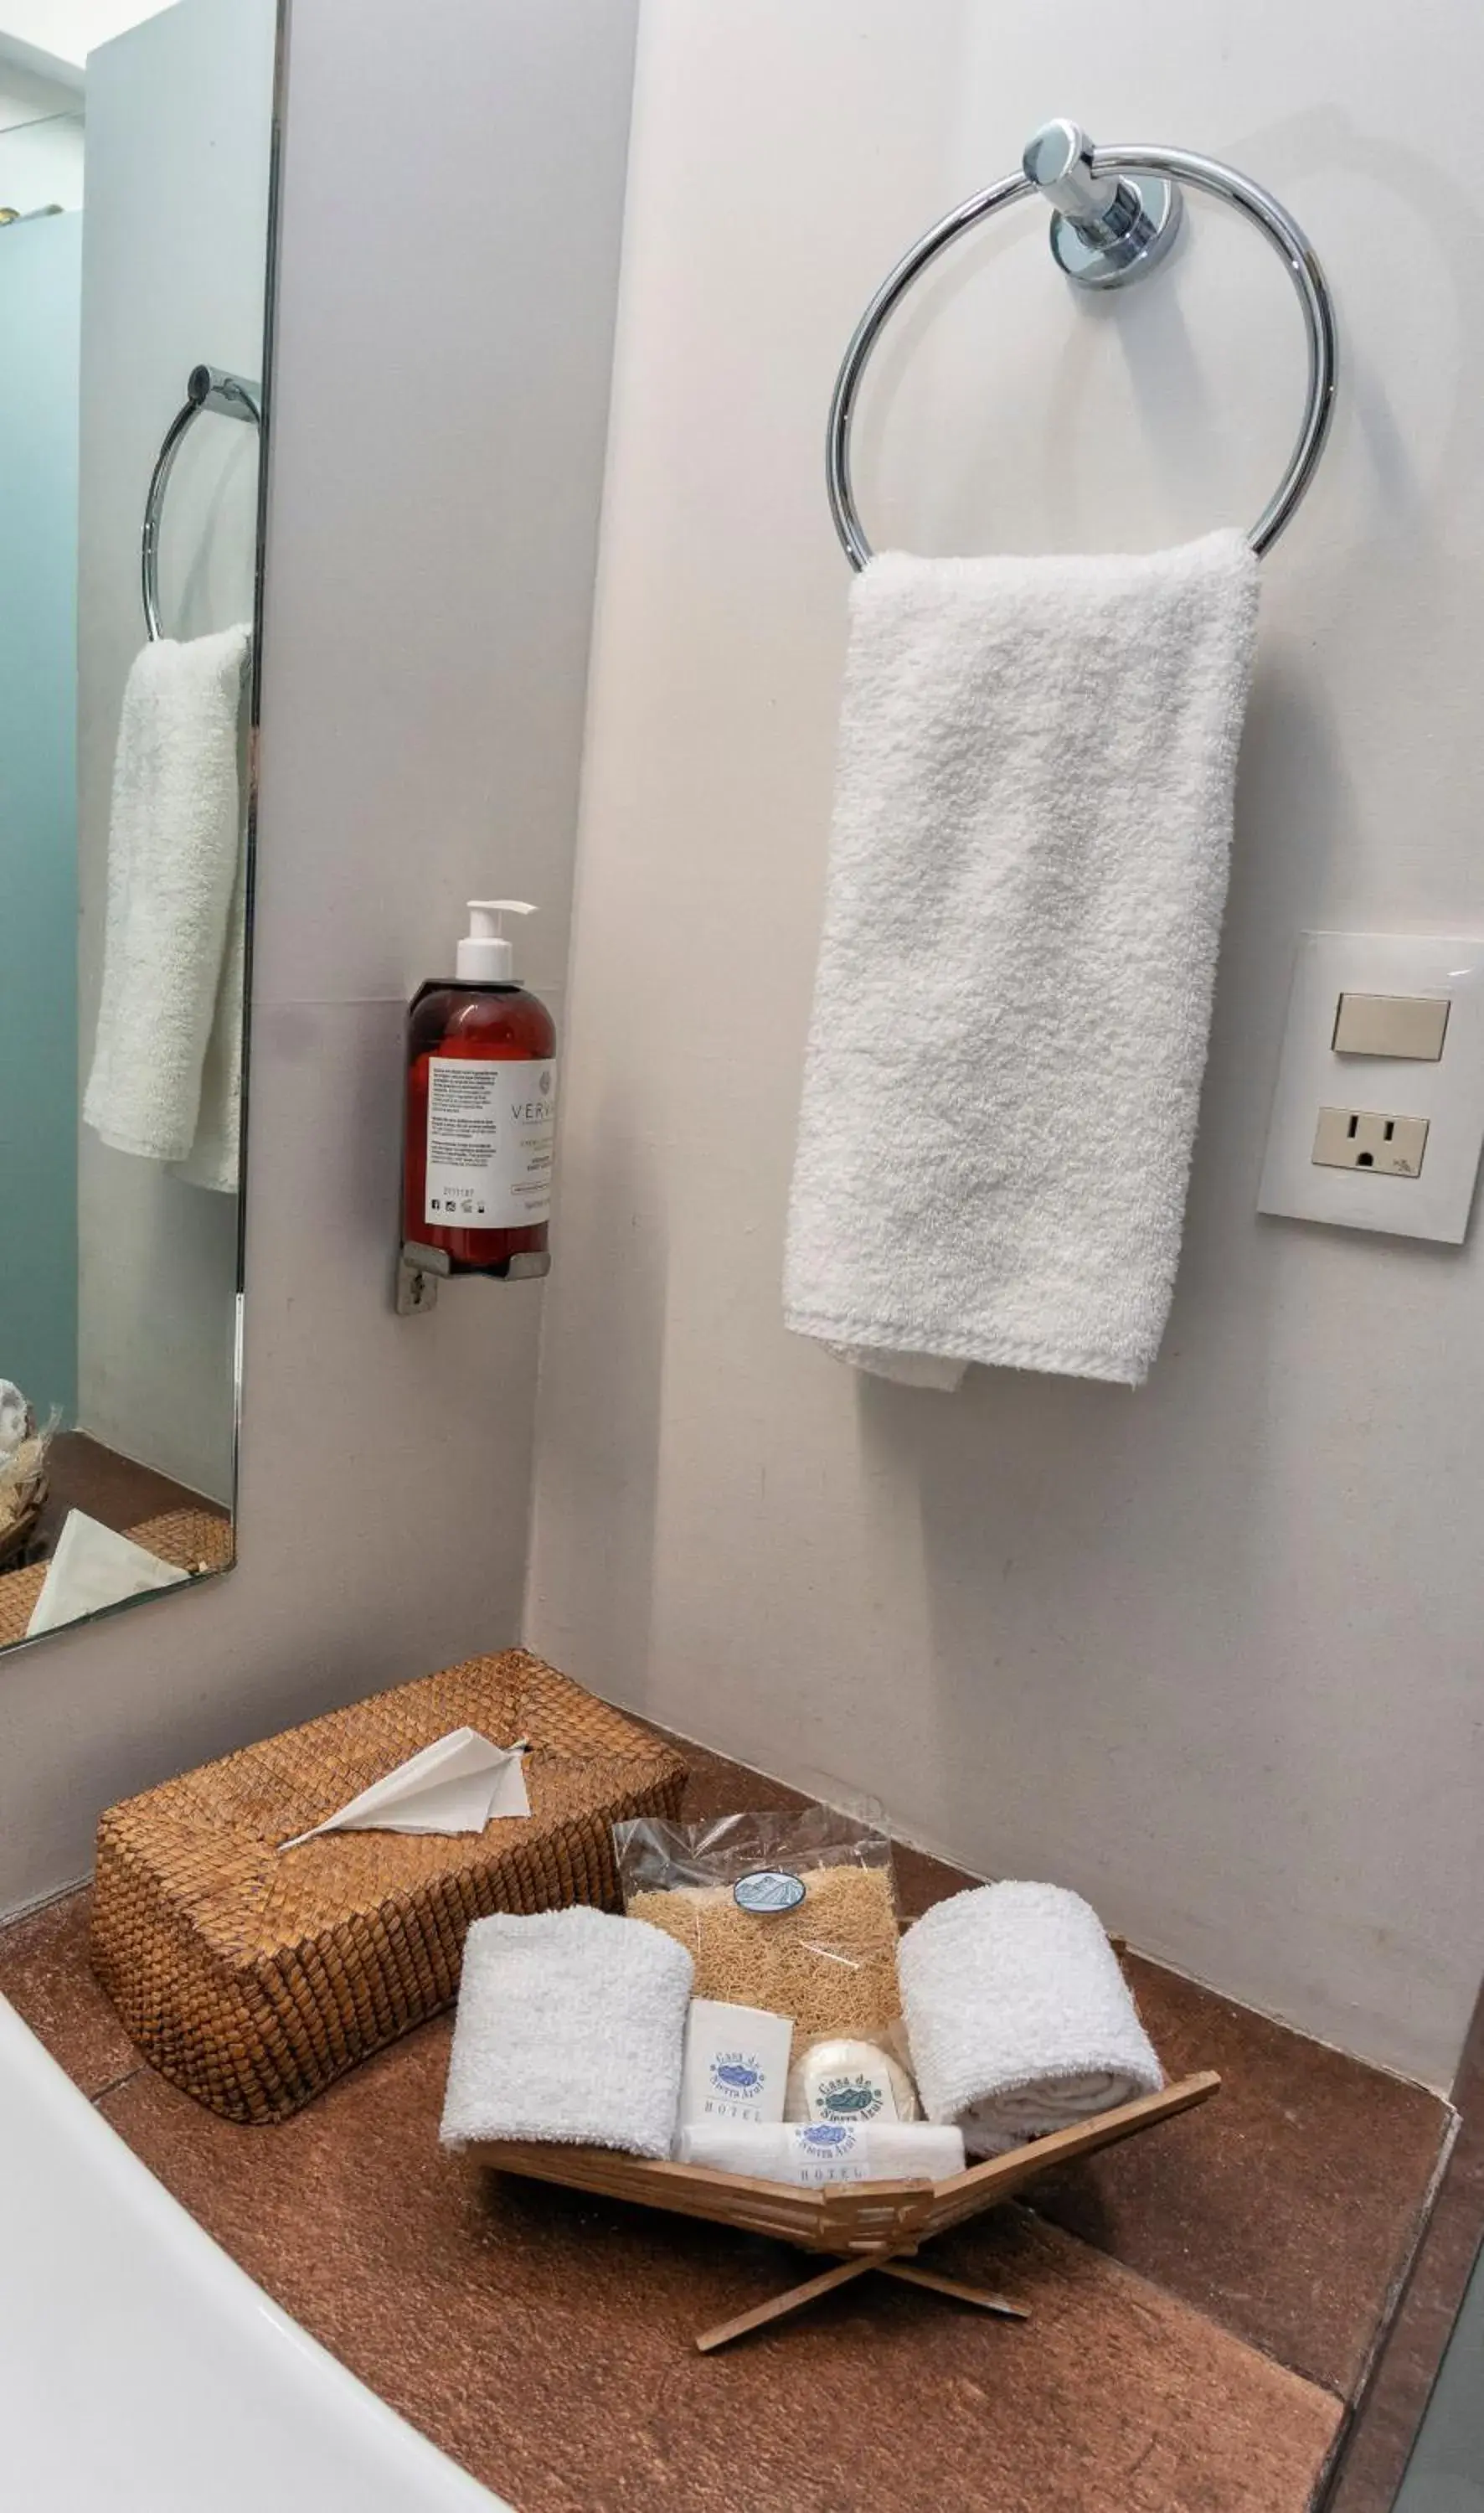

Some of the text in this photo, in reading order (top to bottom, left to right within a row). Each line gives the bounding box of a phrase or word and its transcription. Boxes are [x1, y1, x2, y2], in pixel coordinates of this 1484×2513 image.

[715, 2051, 743, 2064] Casa
[741, 2081, 765, 2099] Azul
[818, 2073, 872, 2095] Casa de
[704, 2099, 763, 2124] HOTEL
[859, 2097, 884, 2122] Azul
[800, 2167, 863, 2181] HOTEL
